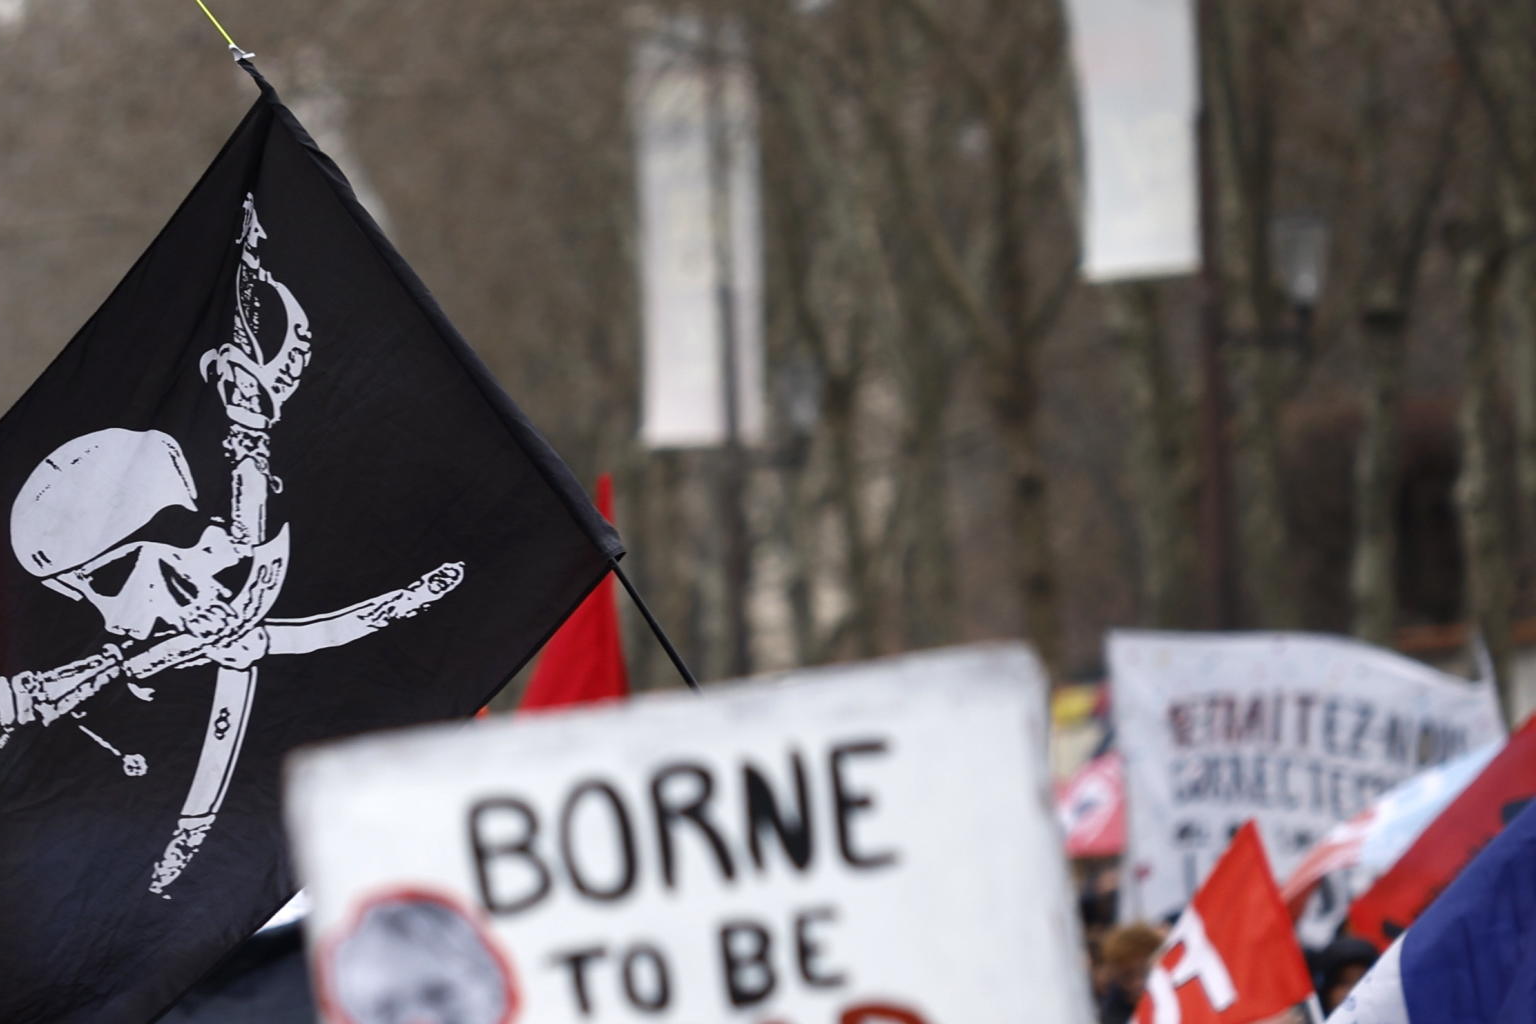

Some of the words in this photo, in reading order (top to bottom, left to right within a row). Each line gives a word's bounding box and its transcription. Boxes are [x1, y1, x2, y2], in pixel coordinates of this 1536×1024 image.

[463, 739, 901, 915] BORNE
[548, 943, 672, 1018] TO
[719, 907, 847, 1008] BE
